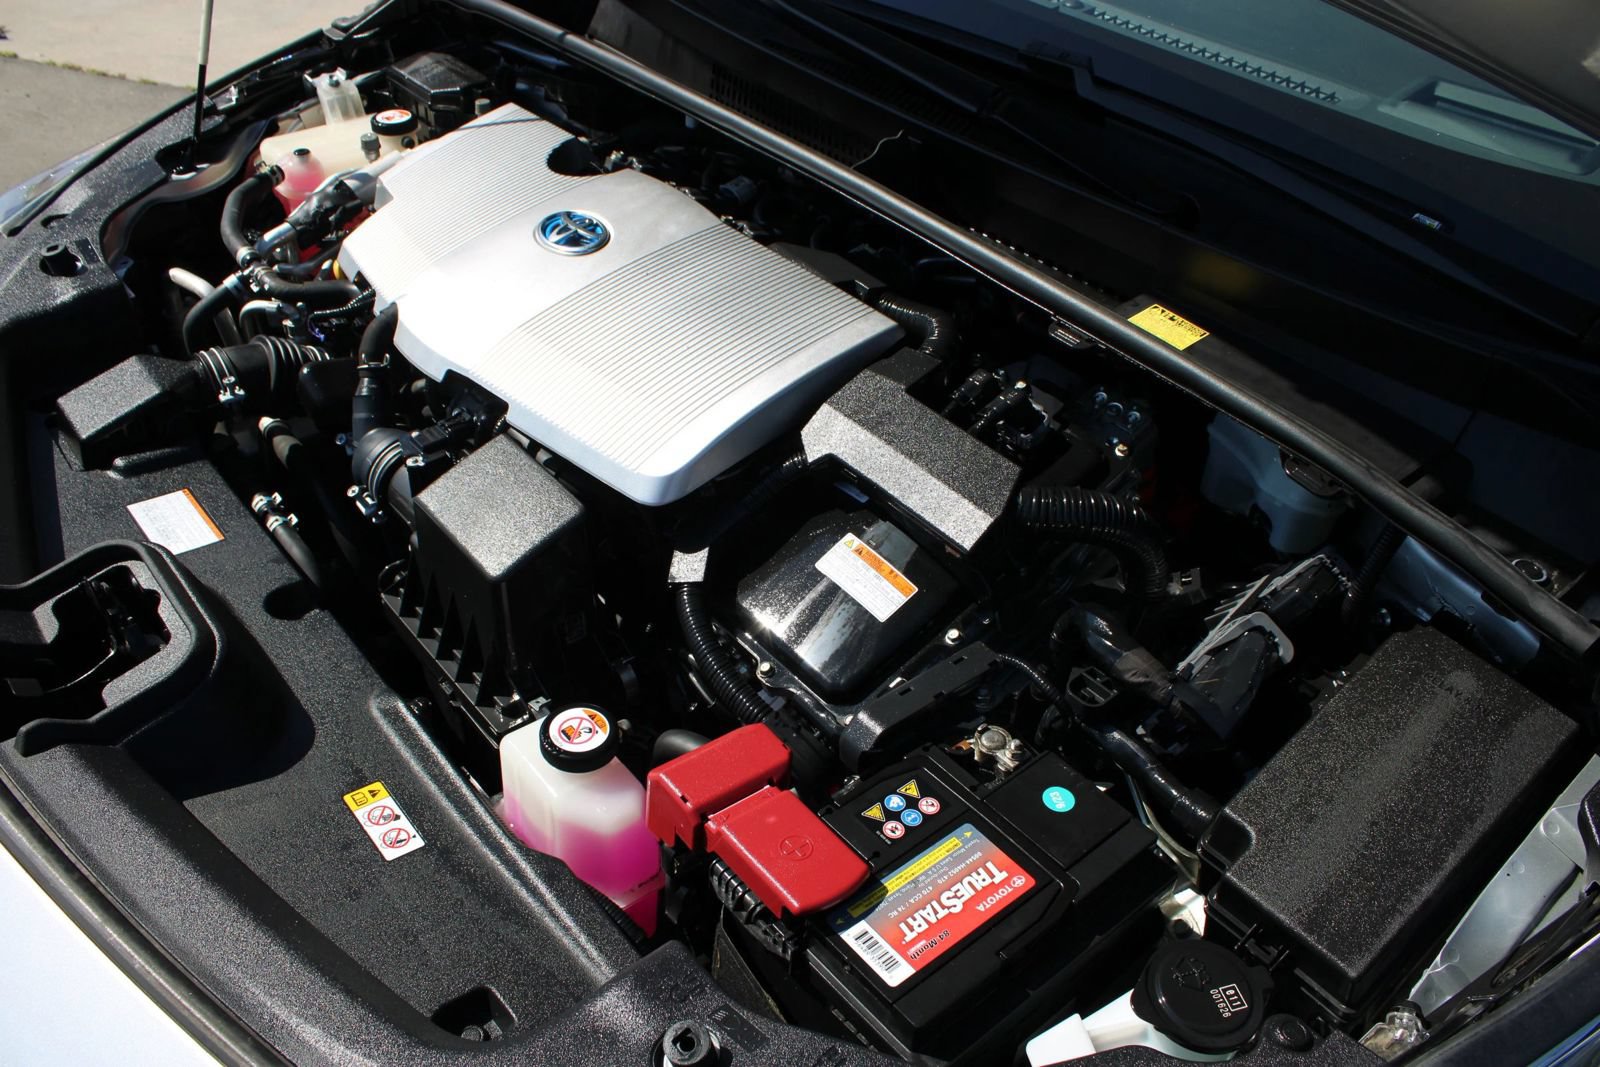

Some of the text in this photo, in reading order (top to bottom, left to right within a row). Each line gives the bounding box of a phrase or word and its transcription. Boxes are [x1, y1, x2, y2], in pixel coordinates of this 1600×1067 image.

[965, 838, 980, 849] Toyota
[909, 892, 922, 903] CCA
[976, 884, 1014, 912] TOYOTA
[888, 910, 899, 919] RC
[938, 929, 950, 941] 84
[910, 938, 938, 960] Month
[1210, 988, 1231, 1018] 001626
[1225, 989, 1241, 1006] e11
